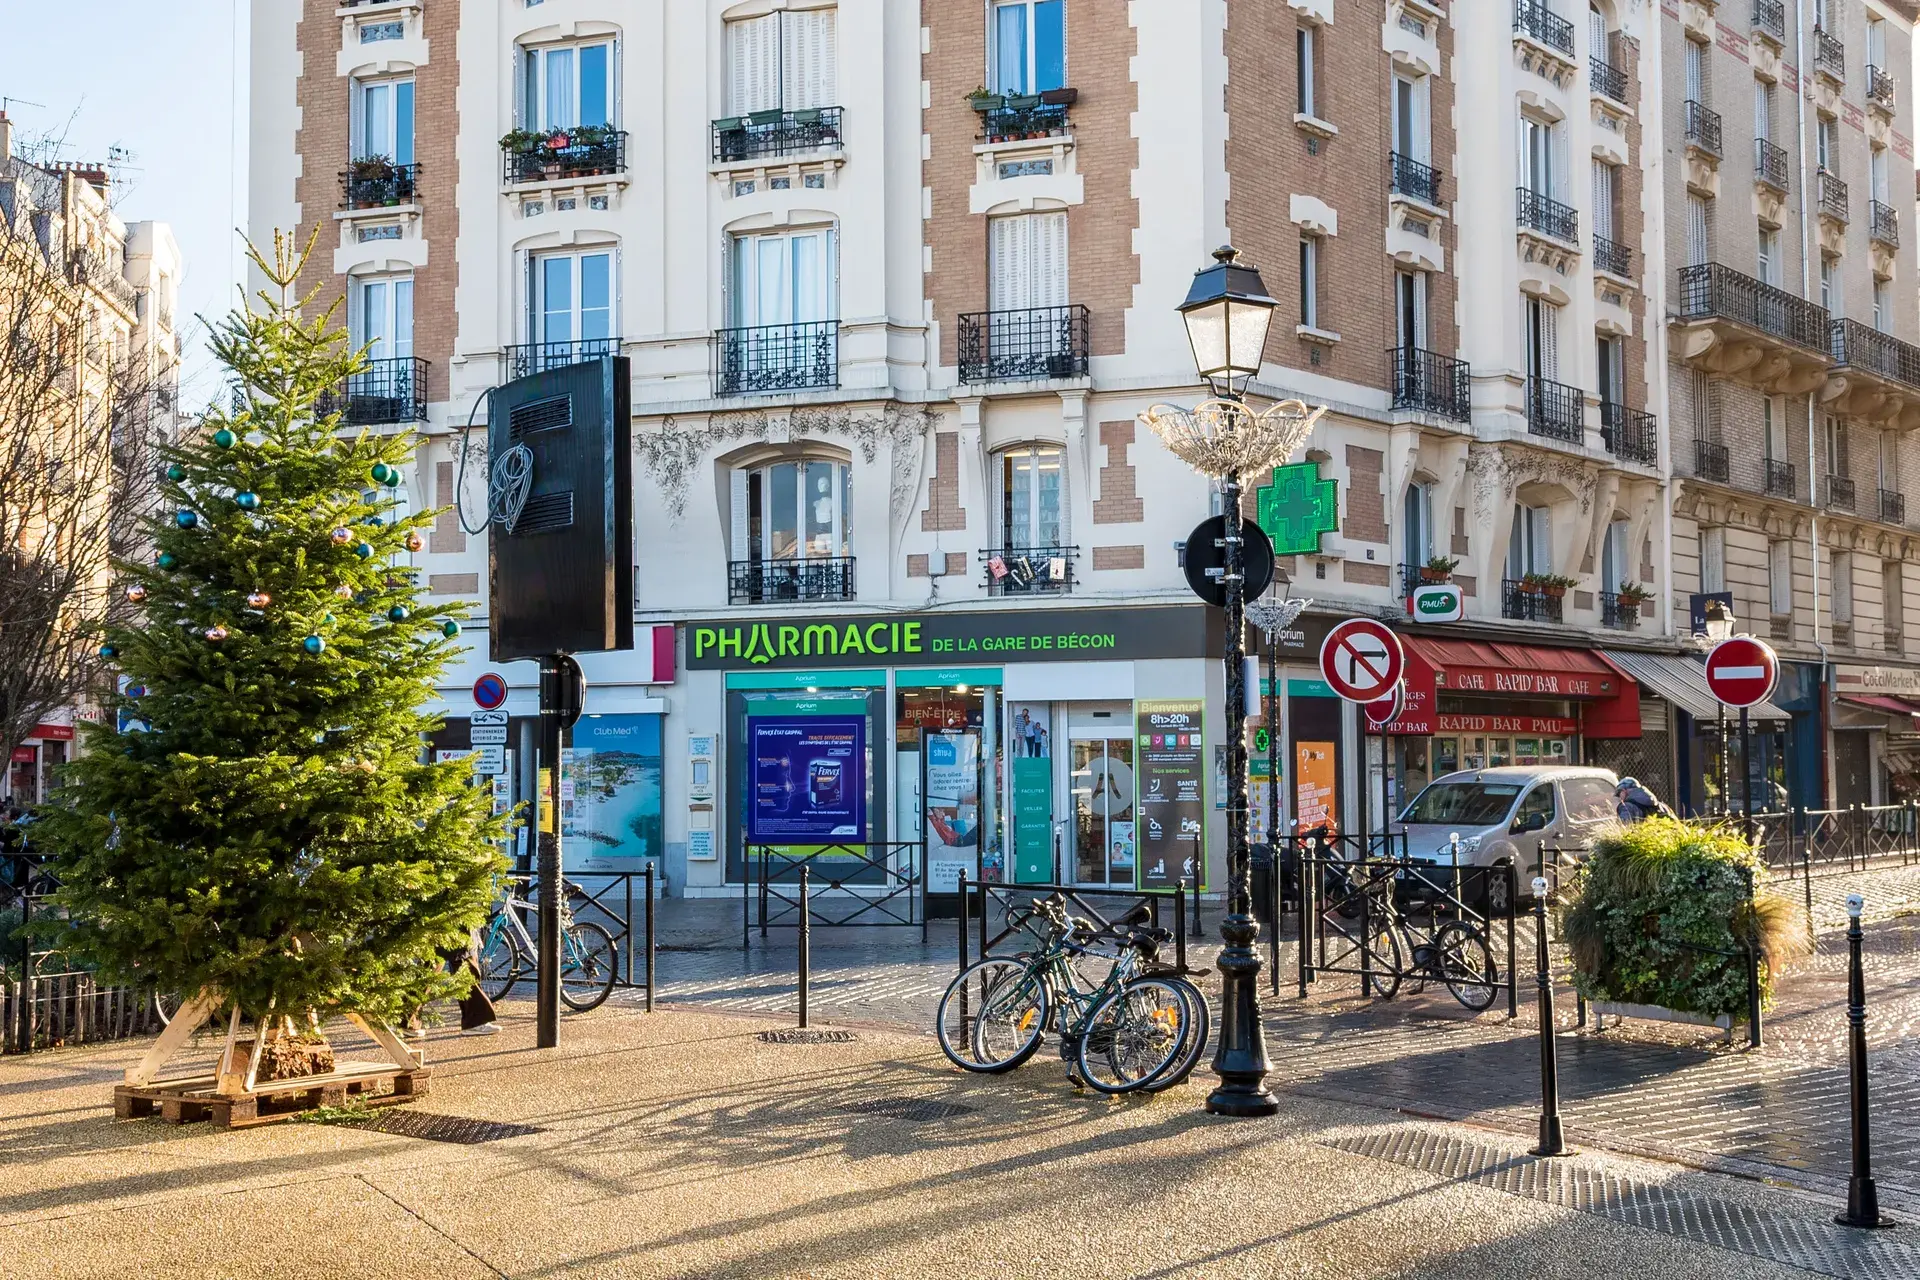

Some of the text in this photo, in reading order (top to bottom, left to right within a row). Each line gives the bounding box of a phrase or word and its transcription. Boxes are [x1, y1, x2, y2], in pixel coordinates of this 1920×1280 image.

[1422, 600, 1439, 608] PMU
[696, 622, 1115, 664] PHARMACIE DE LA GARE DE BÉCON
[1459, 673, 1590, 694] CAFE RAPID' BAR CAFE
[1142, 703, 1198, 712] Bienvenue
[1369, 722, 1428, 732] RAID' BAR
[1440, 717, 1562, 733] RAPID BAR PMU
[594, 727, 612, 735] Club
[818, 767, 840, 776] FERVEX
